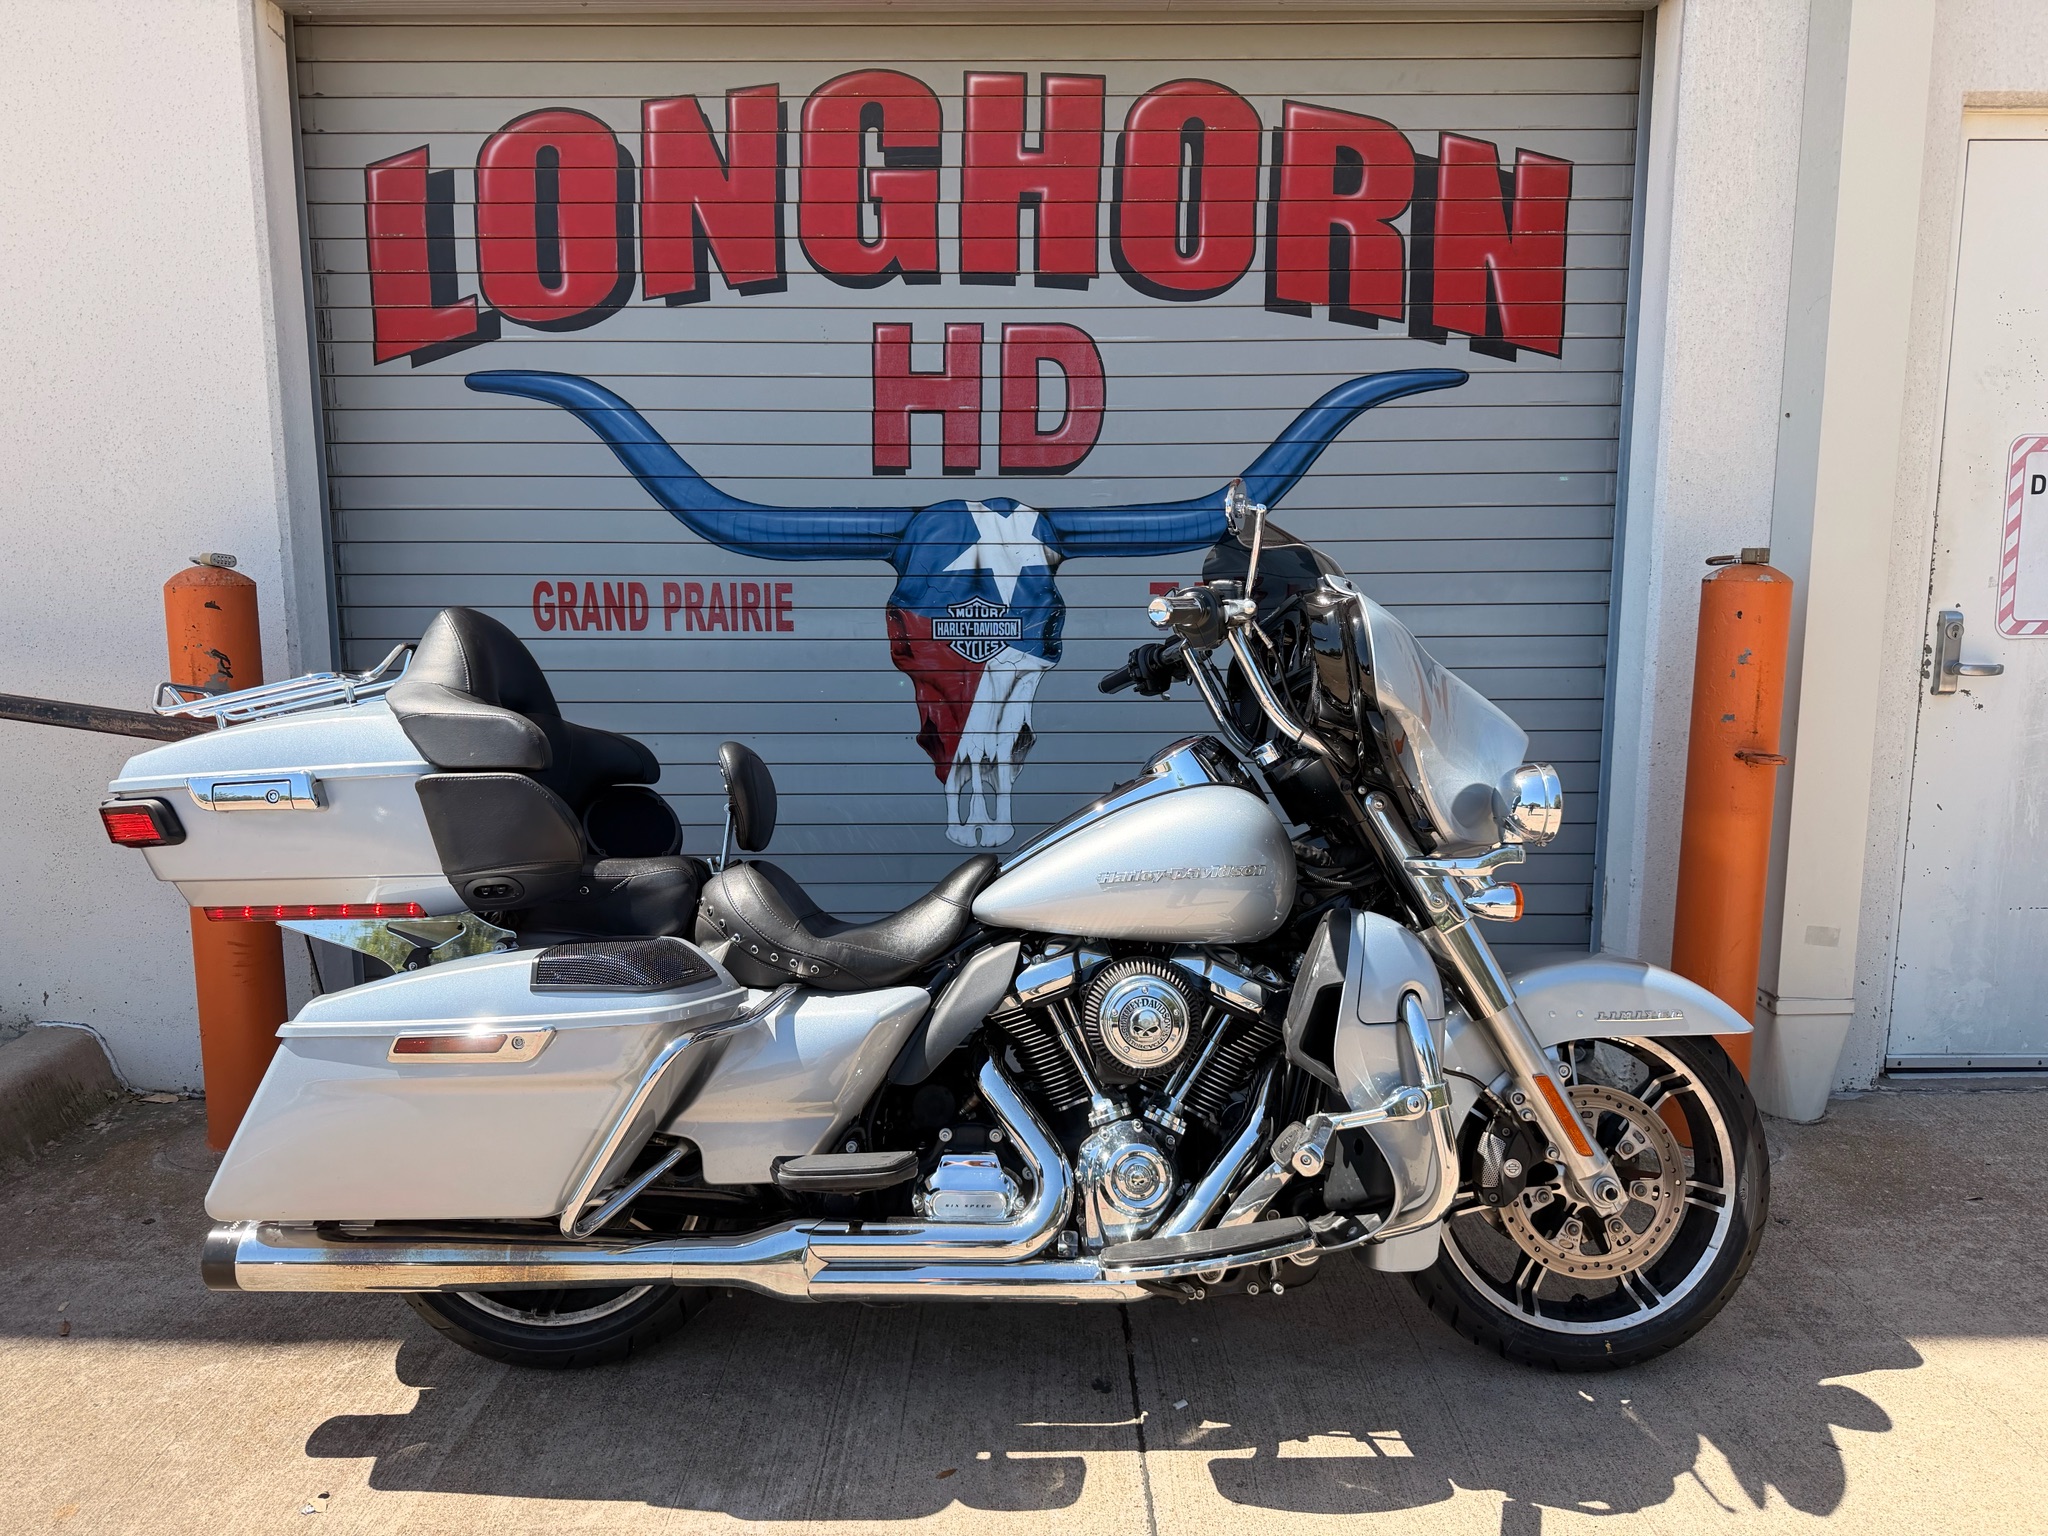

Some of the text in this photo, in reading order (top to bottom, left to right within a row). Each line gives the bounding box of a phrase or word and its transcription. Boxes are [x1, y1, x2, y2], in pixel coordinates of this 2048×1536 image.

[365, 68, 1574, 367] LONGHORN
[873, 322, 1106, 475] HD
[533, 581, 794, 632] GRAND PRAIRIE
[956, 602, 998, 617] MOTOR
[937, 622, 1018, 636] HARLEY-DAVIDSON
[957, 640, 999, 659] CYCLES
[1596, 1009, 1684, 1021] LIMITED
